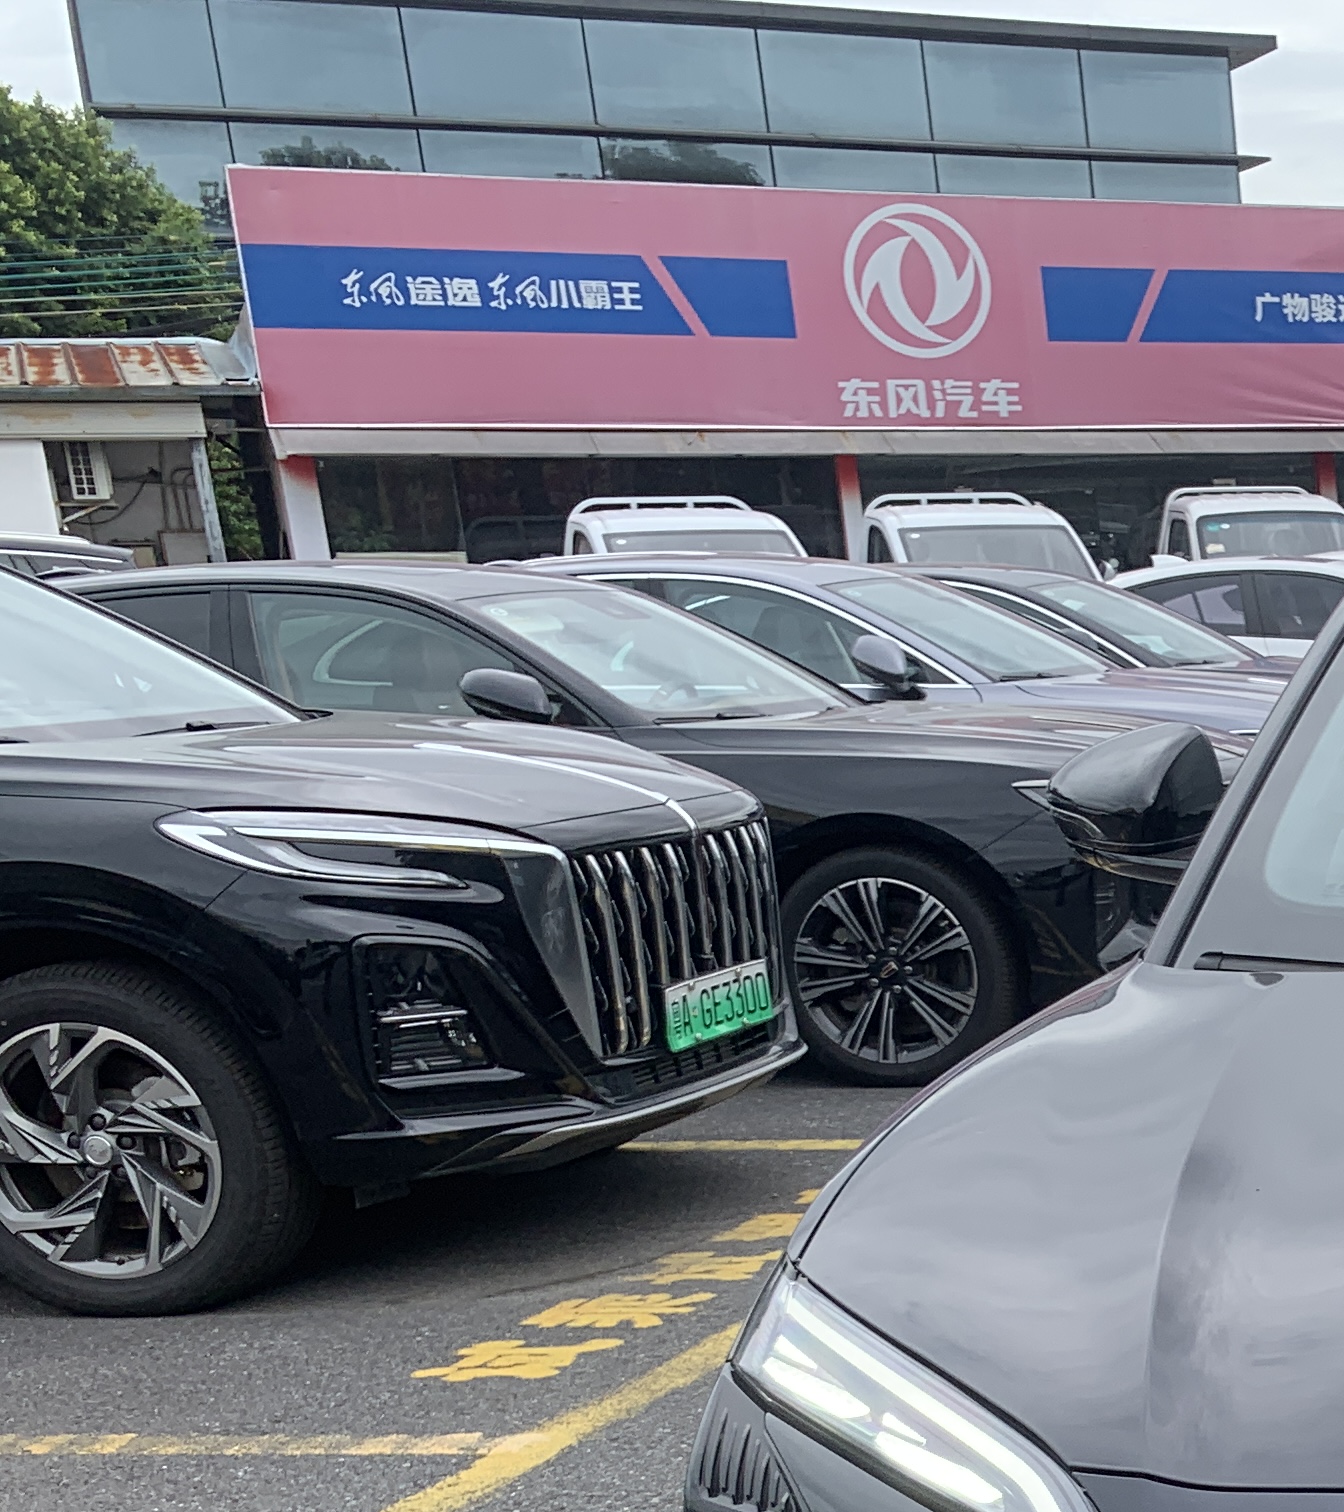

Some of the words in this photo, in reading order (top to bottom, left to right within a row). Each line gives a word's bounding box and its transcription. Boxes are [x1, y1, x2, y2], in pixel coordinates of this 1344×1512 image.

[837, 378, 1023, 418] 东风汽车
[700, 972, 769, 1029] GE3300
